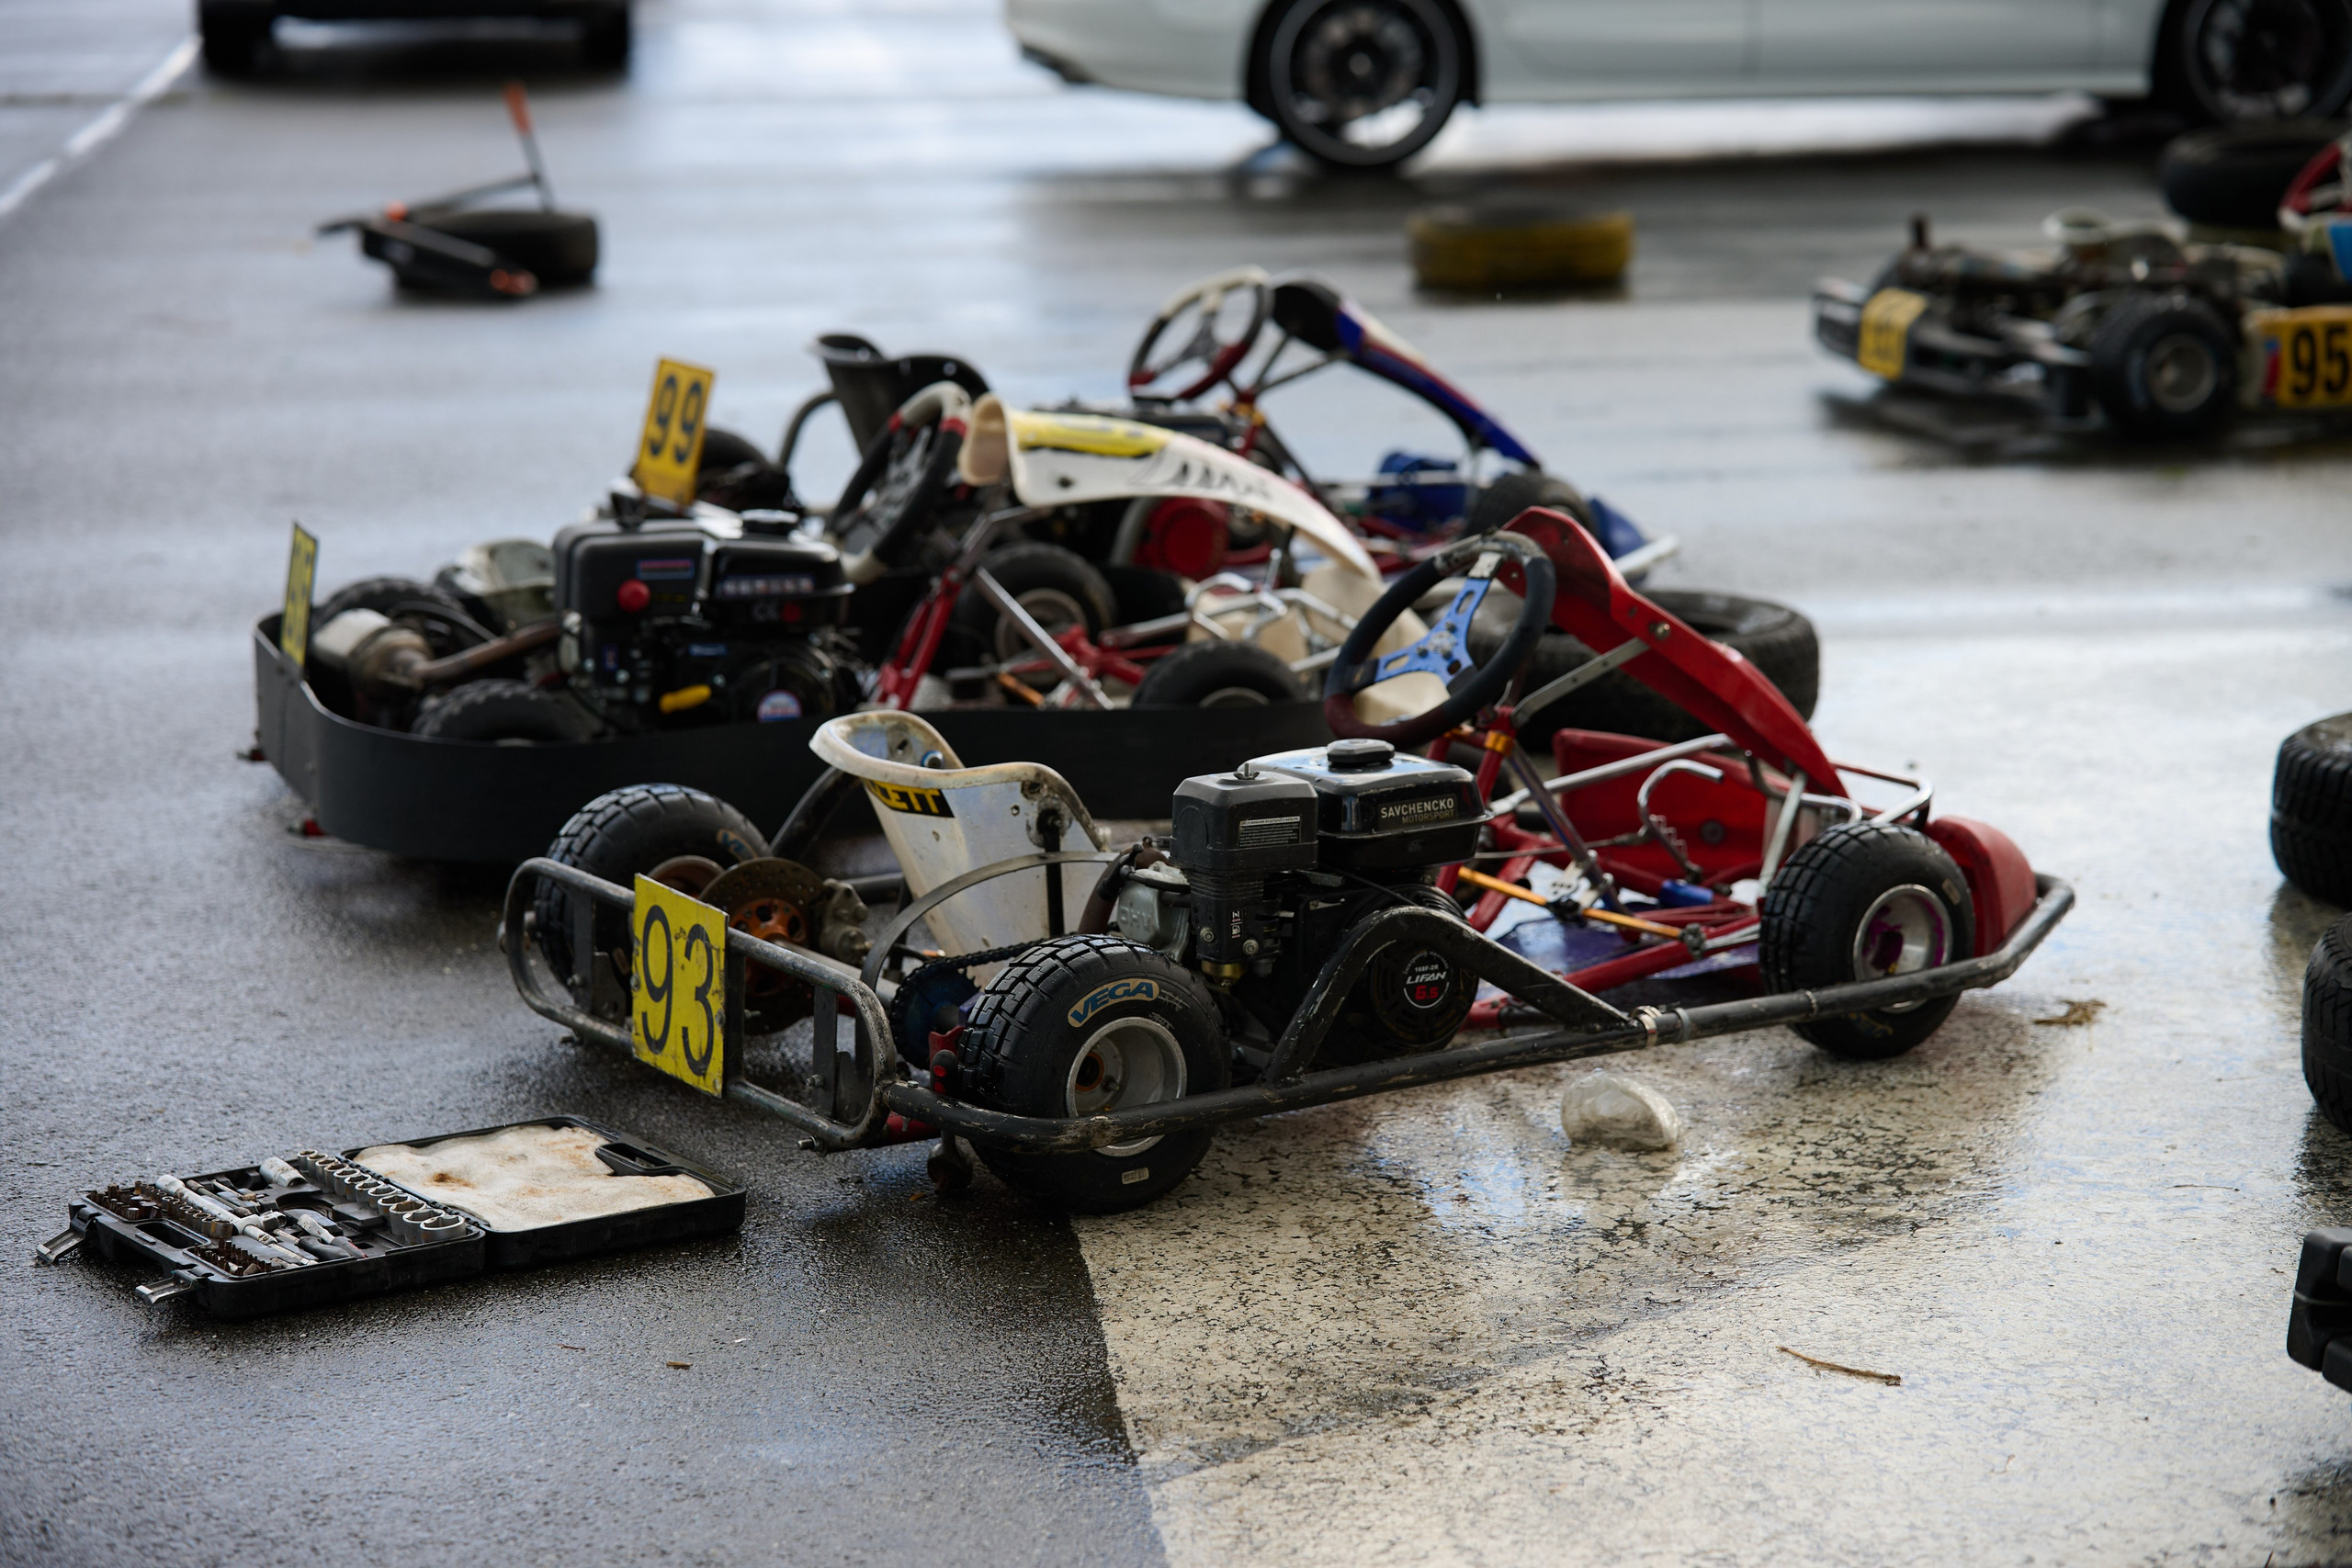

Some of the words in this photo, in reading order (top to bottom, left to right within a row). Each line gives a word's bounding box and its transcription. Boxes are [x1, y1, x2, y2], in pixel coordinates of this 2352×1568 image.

[2292, 323, 2349, 396] 95
[649, 375, 703, 464] 99
[1380, 797, 1454, 818] SAVCHENCKO
[1401, 809, 1455, 824] MOTORSPORT
[641, 905, 715, 1077] 93
[1406, 971, 1447, 984] LIFAN
[1416, 985, 1439, 1000] 6.5
[1070, 981, 1154, 1024] VEGA
